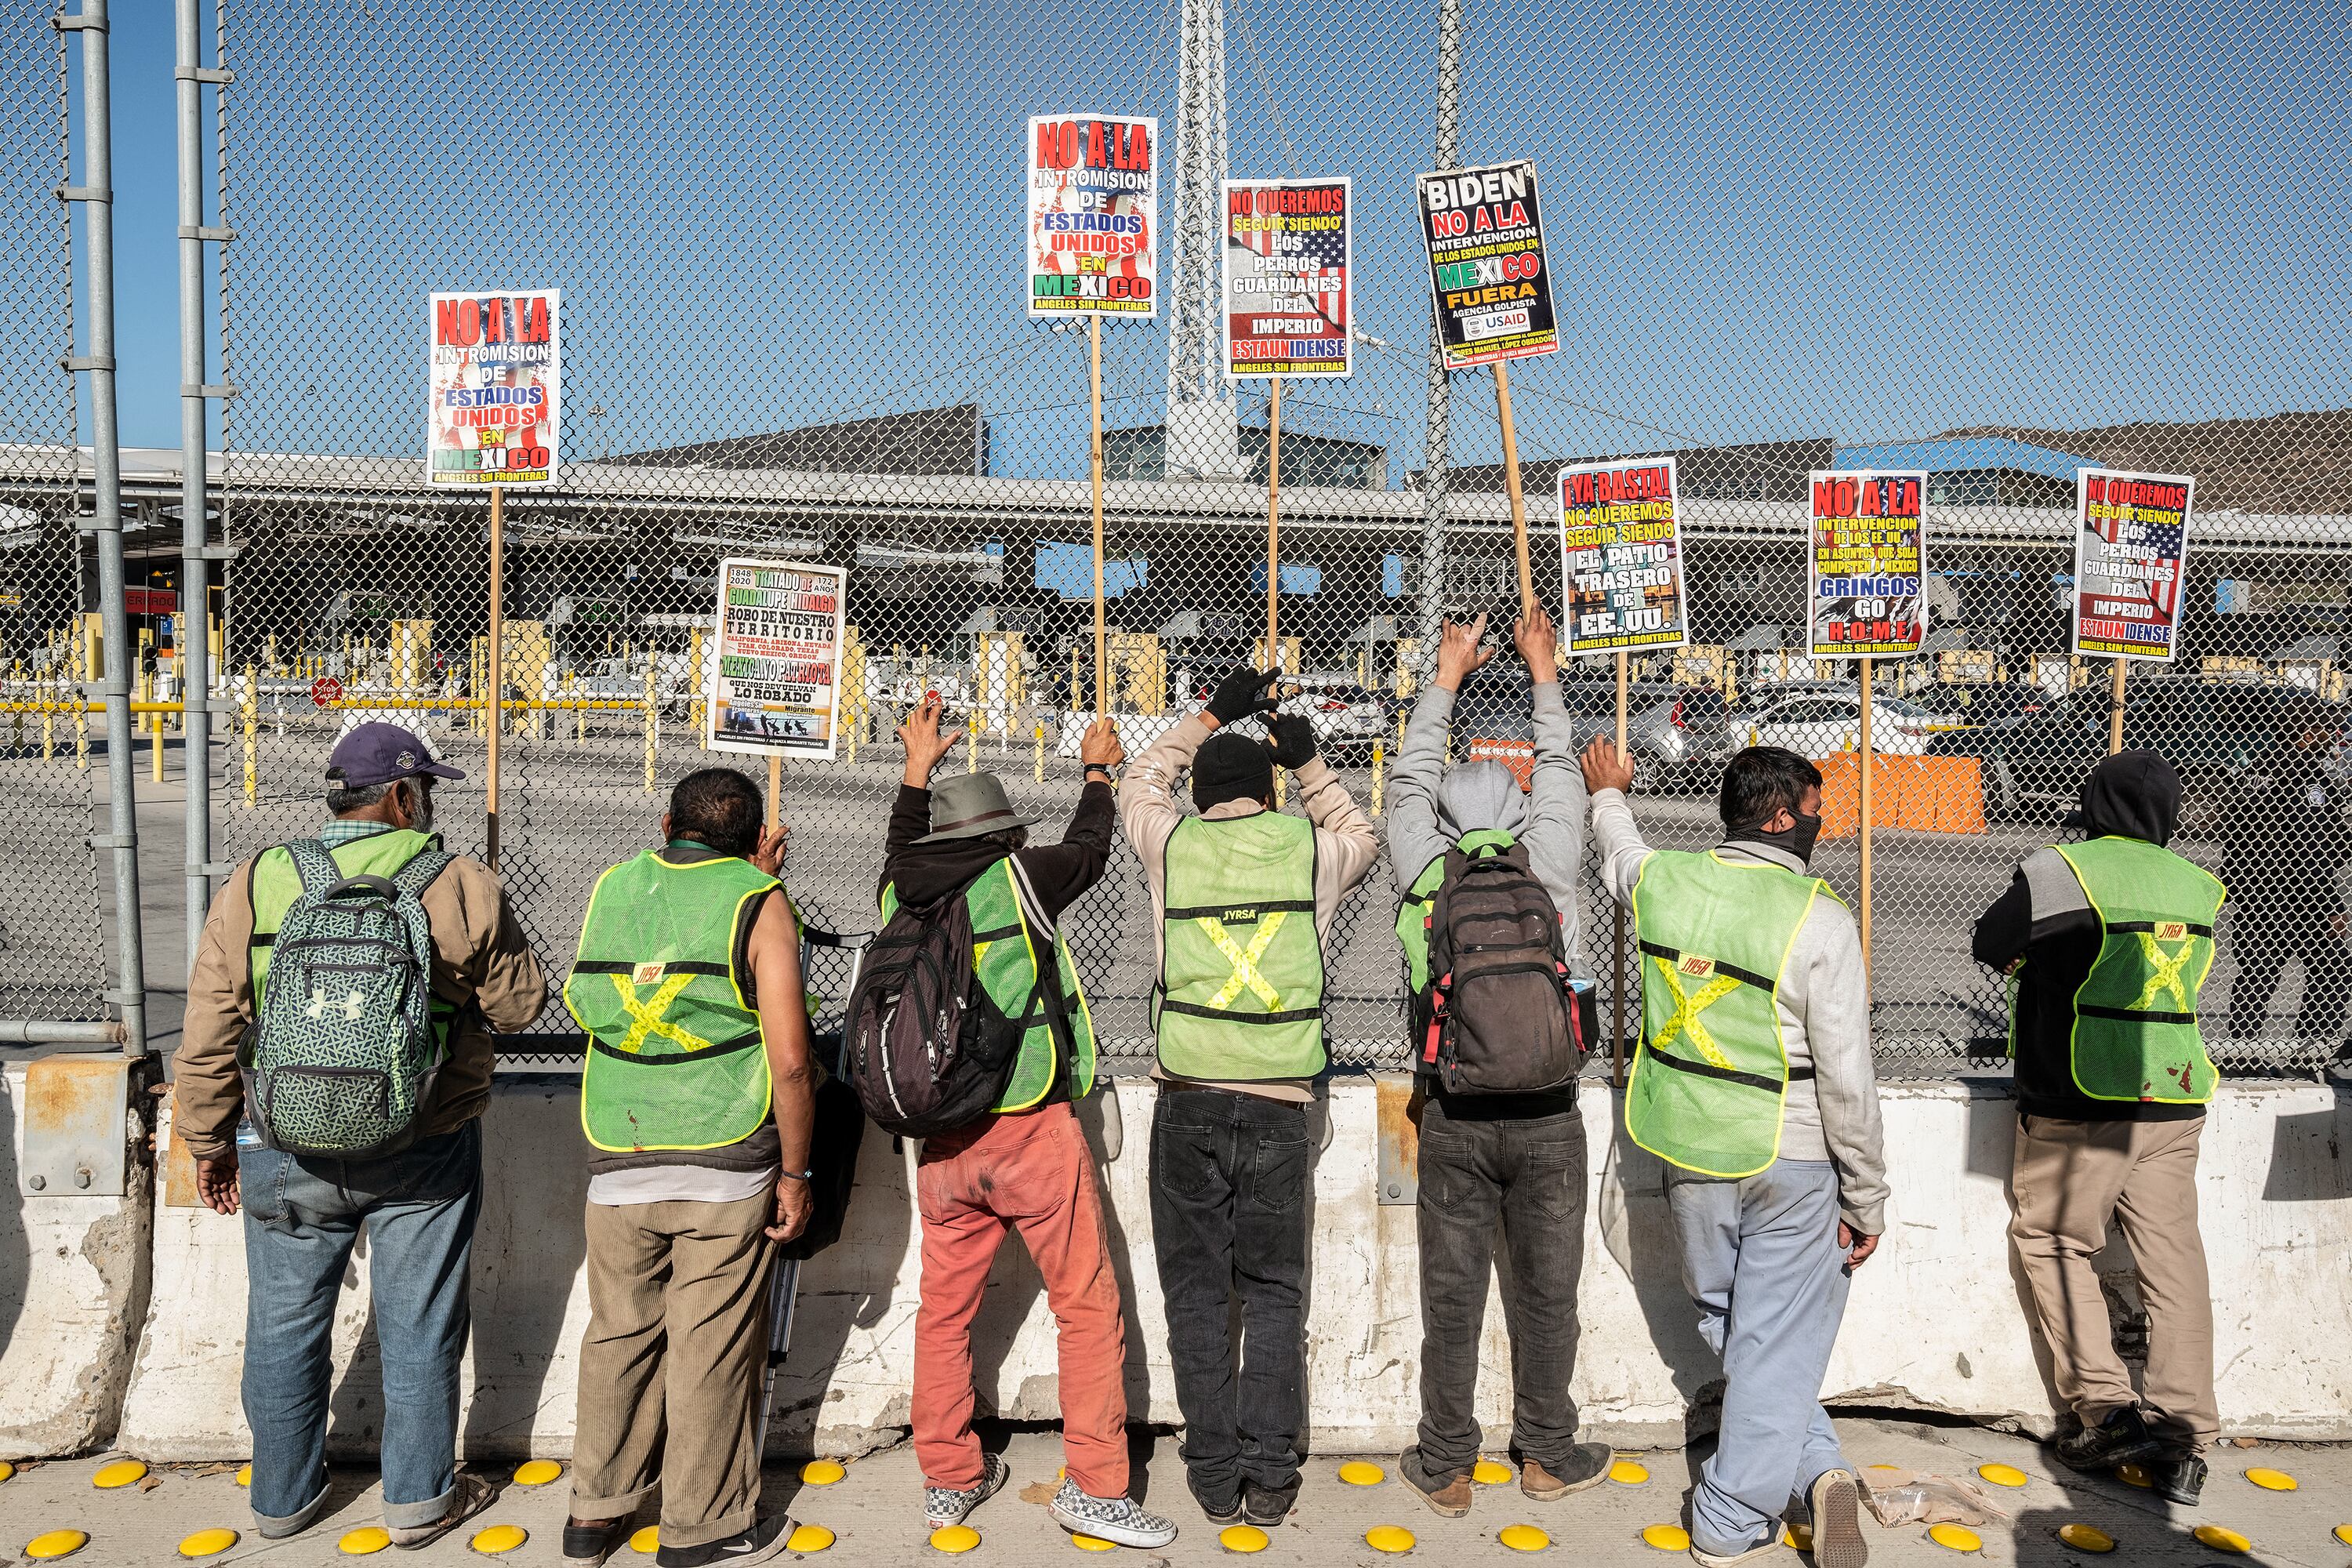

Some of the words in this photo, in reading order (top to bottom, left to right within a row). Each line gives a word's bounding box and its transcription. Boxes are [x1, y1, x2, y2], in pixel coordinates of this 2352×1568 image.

[1037, 121, 1079, 169] NO
[1086, 122, 1106, 169] A
[1113, 123, 1149, 171] LA
[1037, 170, 1149, 190] INTROMISION
[1427, 169, 1527, 211] BIDEN
[1080, 191, 1107, 209] DE
[1230, 191, 1253, 216] NO
[1257, 189, 1343, 216] QUEREMOS
[1044, 212, 1142, 234] ESTADOS
[1233, 216, 1286, 232] SEGUIR
[1289, 216, 1341, 232] SIENDO
[1432, 209, 1468, 238] NO
[1474, 206, 1494, 233] A
[1496, 201, 1529, 230] LA
[1051, 234, 1135, 254] UNIDOS
[1271, 235, 1303, 251] LOS
[1432, 226, 1537, 252] INTERVENCION
[1433, 252, 1446, 263] DE
[1445, 250, 1461, 262] LOS
[1461, 245, 1497, 260] ESTADOS
[1497, 240, 1526, 256] UNIDOS
[1526, 238, 1538, 249] EN
[1080, 256, 1106, 272] EN
[1253, 256, 1321, 273] PERROS
[1437, 252, 1540, 292] MEXICO
[1034, 275, 1151, 299] MEXICO
[1232, 276, 1343, 294] GUARDIANES
[1035, 299, 1077, 310] ANGELES
[1078, 300, 1095, 310] SIN
[1097, 300, 1150, 311] FRONTERAS
[1446, 282, 1537, 309] FUERA
[1271, 297, 1304, 314] DEL
[1453, 305, 1494, 319] AGENCIA
[1494, 298, 1537, 312] GOLPISTA
[437, 299, 481, 346] NO
[486, 298, 506, 343] A
[514, 297, 550, 343] LA
[1252, 318, 1324, 335] IMPERIO
[1486, 313, 1527, 328] USAID
[438, 344, 549, 365] INTROMISION
[1231, 339, 1346, 360] ESTAUNIDENSE
[1474, 344, 1501, 354] MANUEL
[1502, 339, 1521, 350] LÓPEZ
[1232, 363, 1272, 373] ANGELES
[1274, 363, 1289, 372] SIN
[1290, 361, 1345, 372] FRONTERAS
[1474, 353, 1498, 362] FRONTERAS
[480, 365, 507, 383] DE
[445, 386, 543, 407] ESTADOS
[452, 408, 536, 427] UNIDOS
[481, 429, 505, 445] EN
[433, 446, 550, 470] MEXICO
[434, 472, 478, 483] ANGELES
[479, 472, 494, 483] SIN
[494, 470, 548, 482] FRONTERAS
[1564, 474, 1595, 508] ¡YA
[1598, 466, 1670, 502] BASTA!
[2088, 479, 2106, 501] NO
[2108, 481, 2185, 509] QUEREMOS
[1814, 481, 1854, 517] NO
[1861, 481, 1882, 516] A
[1888, 481, 1919, 515] LA
[1565, 509, 1585, 527] NO
[1590, 501, 1673, 526] QUEREMOS
[2089, 504, 2135, 521] SEGUIR
[2136, 508, 2180, 525] SIENDO
[1817, 518, 1917, 531] INTERVENCION
[2117, 524, 2147, 540] LOS
[1566, 528, 1617, 547] SEGUIR
[1621, 522, 1675, 543] SIENDO
[1834, 532, 1847, 545] DE
[1849, 532, 1869, 544] LOS
[1886, 532, 1903, 543] UU.
[1575, 550, 1599, 569] EL
[1607, 543, 1668, 566] PATIO
[1817, 548, 1830, 559] EN
[1832, 547, 1875, 559] ASUNTOS
[1878, 547, 1895, 559] QUE
[1897, 547, 1917, 558] SOLO
[2100, 542, 2158, 561] PERROS
[1817, 561, 1871, 574] COMPETEN
[1875, 561, 1881, 572] A
[1884, 560, 1918, 573] MEXICO
[2084, 560, 2175, 583] GUARDIANES
[731, 568, 751, 577] 1848
[755, 570, 800, 591] TRATADO
[801, 578, 812, 592] DE
[818, 577, 833, 586] 172
[814, 583, 835, 593] AÑOS
[1575, 567, 1671, 592] TRASERO
[1820, 578, 1918, 597] GRINGOS
[2111, 582, 2140, 599] DEL
[728, 588, 787, 609] GUADALUPE
[790, 593, 836, 613] HIDALGO
[1613, 593, 1635, 608] DE
[1854, 599, 1886, 618] GO
[2094, 600, 2154, 619] IMPERIO
[728, 608, 759, 622] ROBO
[760, 611, 777, 624] DE
[779, 612, 834, 628] NUESTRO
[1580, 608, 1672, 637] EE.UU.
[727, 621, 834, 641] TERRITORIO
[727, 635, 770, 644] CALIFORNIA,
[1573, 637, 1610, 650] ANGELES
[1612, 636, 1628, 646] SIN
[1630, 631, 1682, 645] FRONTERAS
[1829, 622, 1907, 641] HOME
[2079, 618, 2171, 644] ESTAUNIDENSE
[1814, 644, 1853, 653] ANGELES
[1854, 644, 1871, 652] SIN
[1872, 642, 1918, 652] FRONTERAS
[2079, 640, 2105, 652] ANGELES
[2106, 643, 2122, 652] SIN
[2124, 644, 2169, 656] FRONTERAS
[722, 655, 777, 682] MEXICANO
[778, 660, 832, 686] PATRIOTA
[734, 688, 755, 699] LO
[757, 689, 811, 703] ROBADO
[746, 681, 764, 690] NOS
[764, 683, 816, 693] DEVUELVAN
[728, 699, 753, 708] Angeles
[753, 700, 764, 709] Sin
[732, 706, 760, 714] Fronteras
[785, 705, 815, 714] Migrante
[1223, 909, 1256, 920] JYRSA
